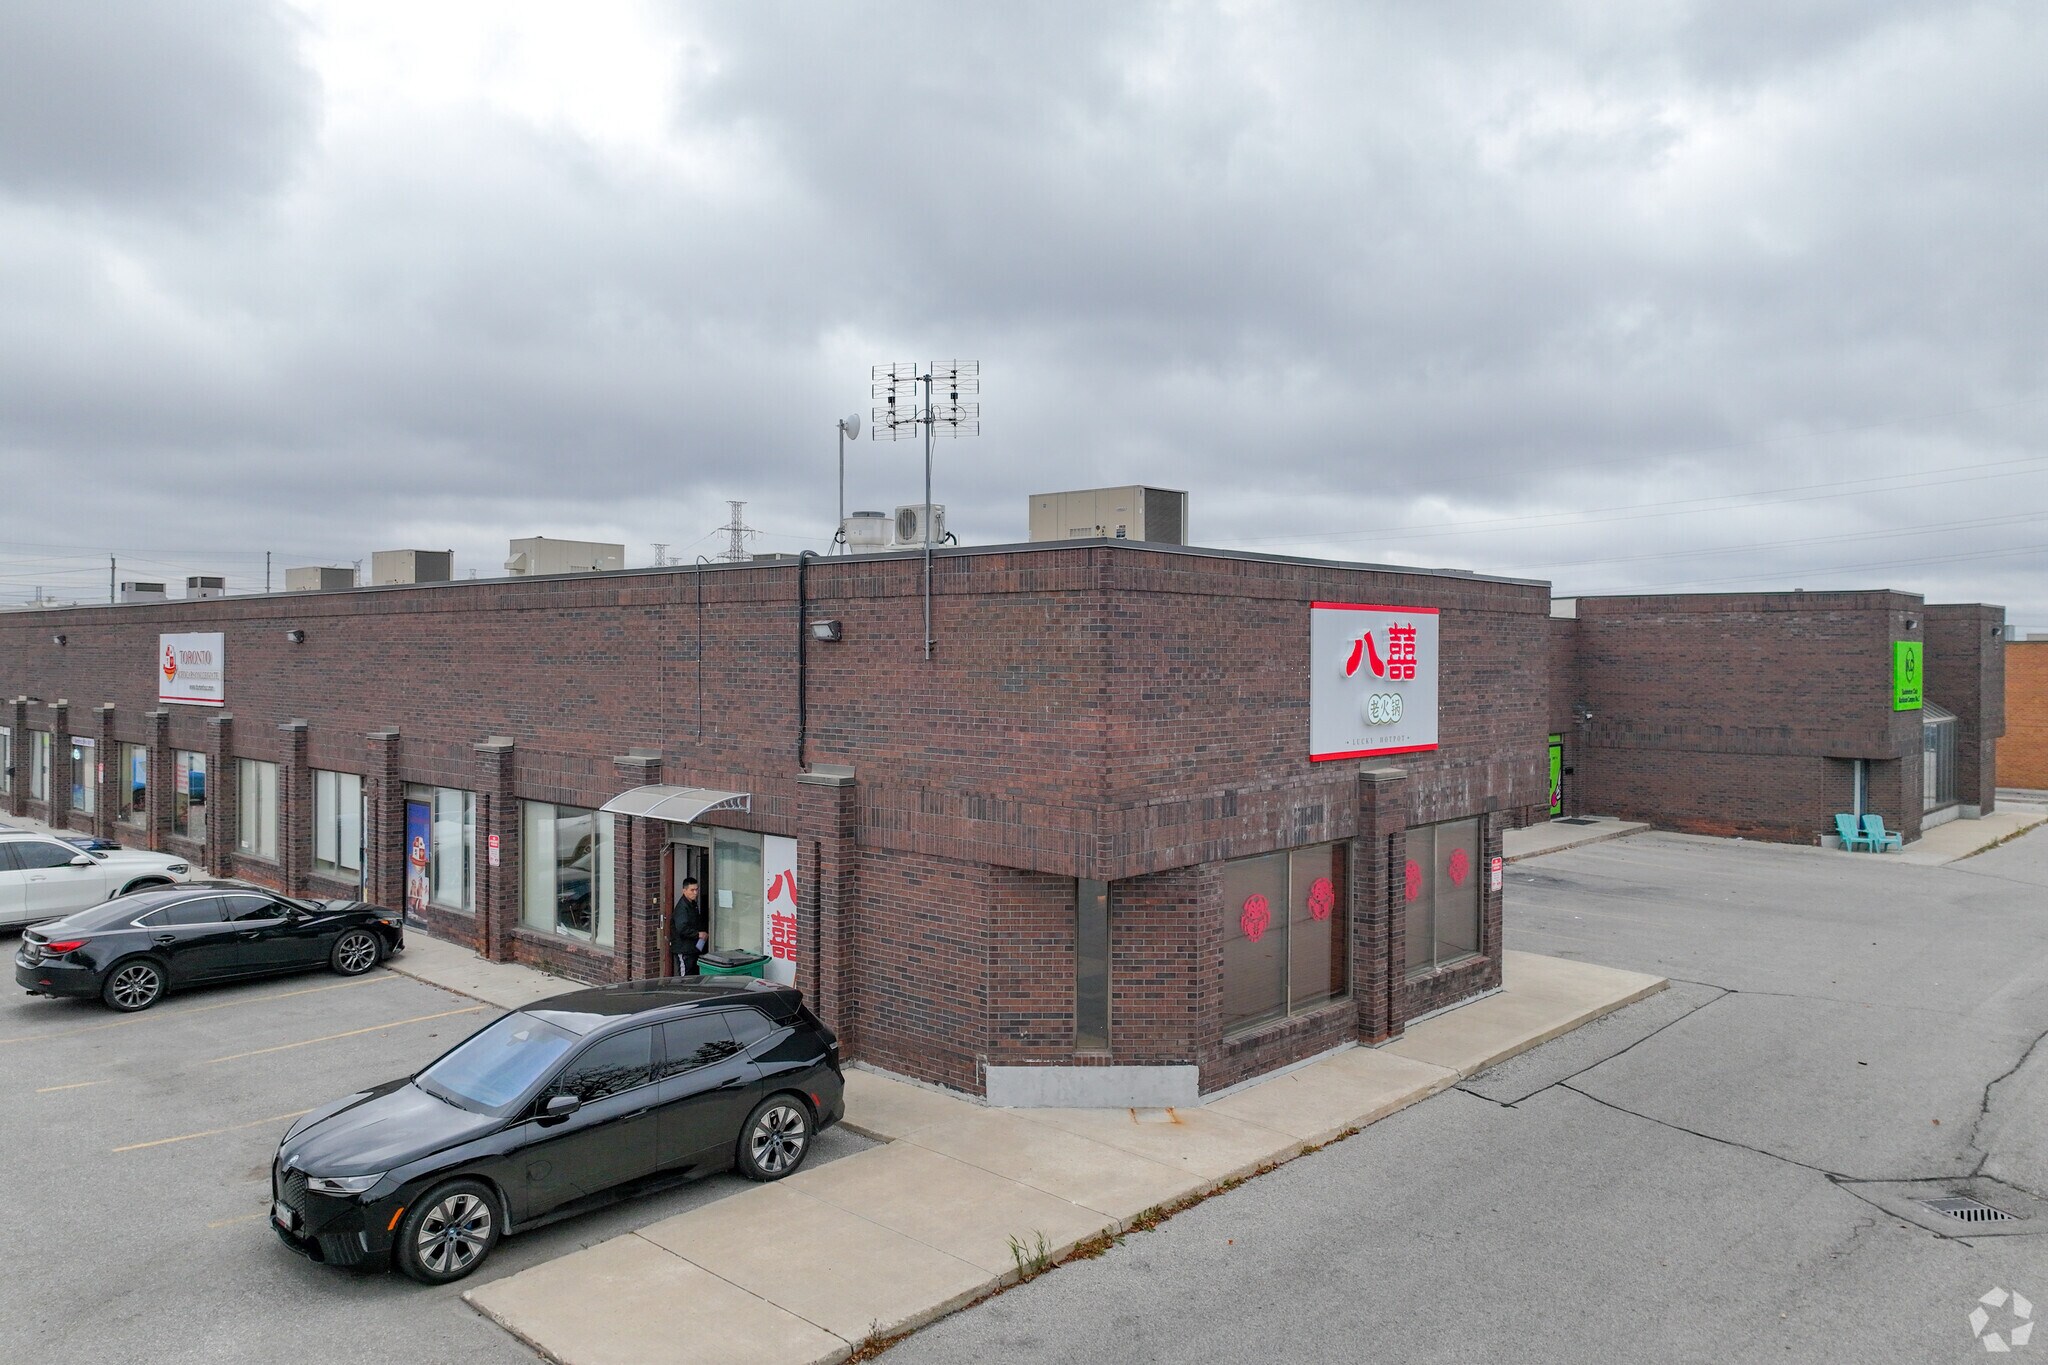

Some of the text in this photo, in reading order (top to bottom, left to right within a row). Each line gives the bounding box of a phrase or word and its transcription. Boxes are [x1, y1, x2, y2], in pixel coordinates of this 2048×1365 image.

[179, 650, 212, 665] TORONTO
[1370, 699, 1401, 719] 老火锅
[1352, 735, 1405, 746] LUCKY HOTPOT
